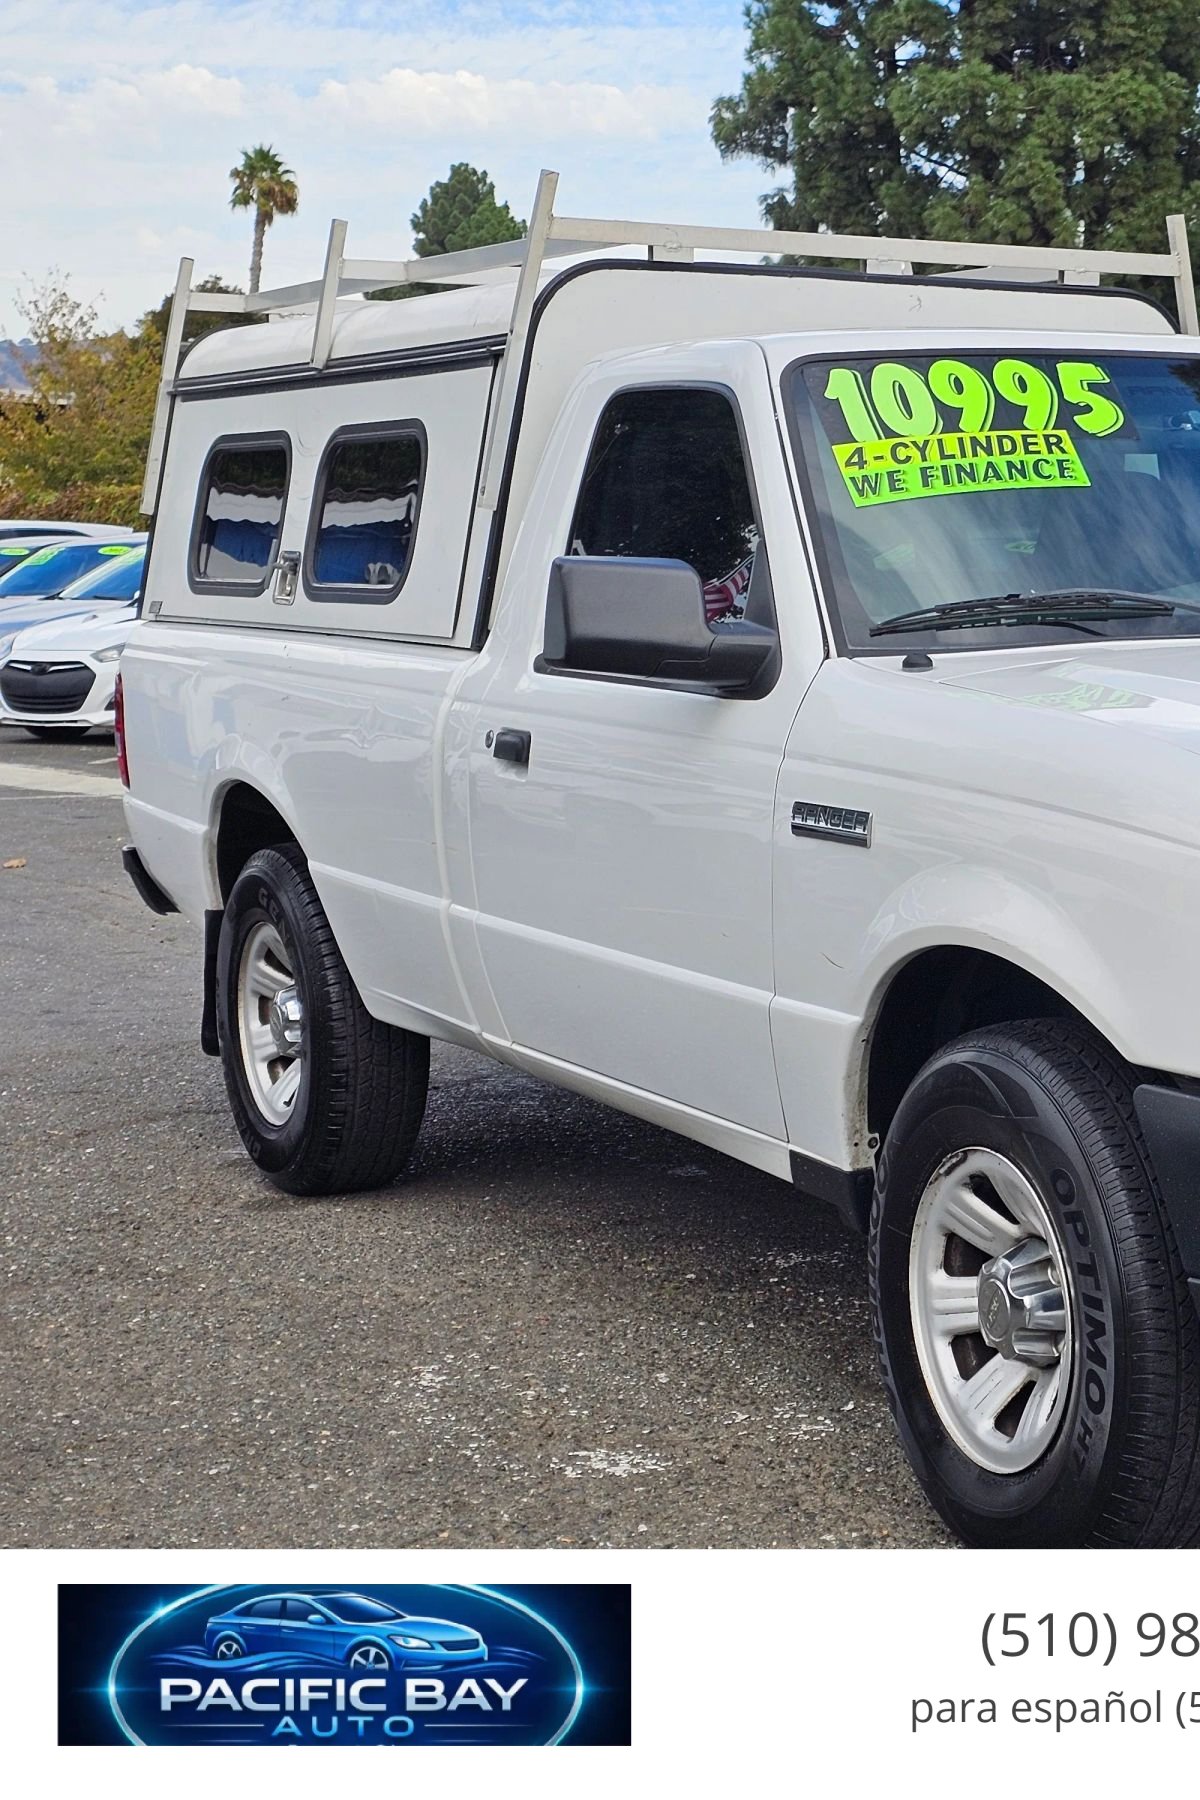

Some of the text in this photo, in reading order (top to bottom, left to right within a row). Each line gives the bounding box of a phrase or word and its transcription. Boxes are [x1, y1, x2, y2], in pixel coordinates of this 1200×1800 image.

[824, 358, 1124, 442] 10995
[844, 433, 1069, 471] 4-CYLINDER
[850, 457, 1075, 498] WE FINANCE
[791, 802, 869, 832] RANGER
[1050, 1167, 1108, 1416] OPTIMO
